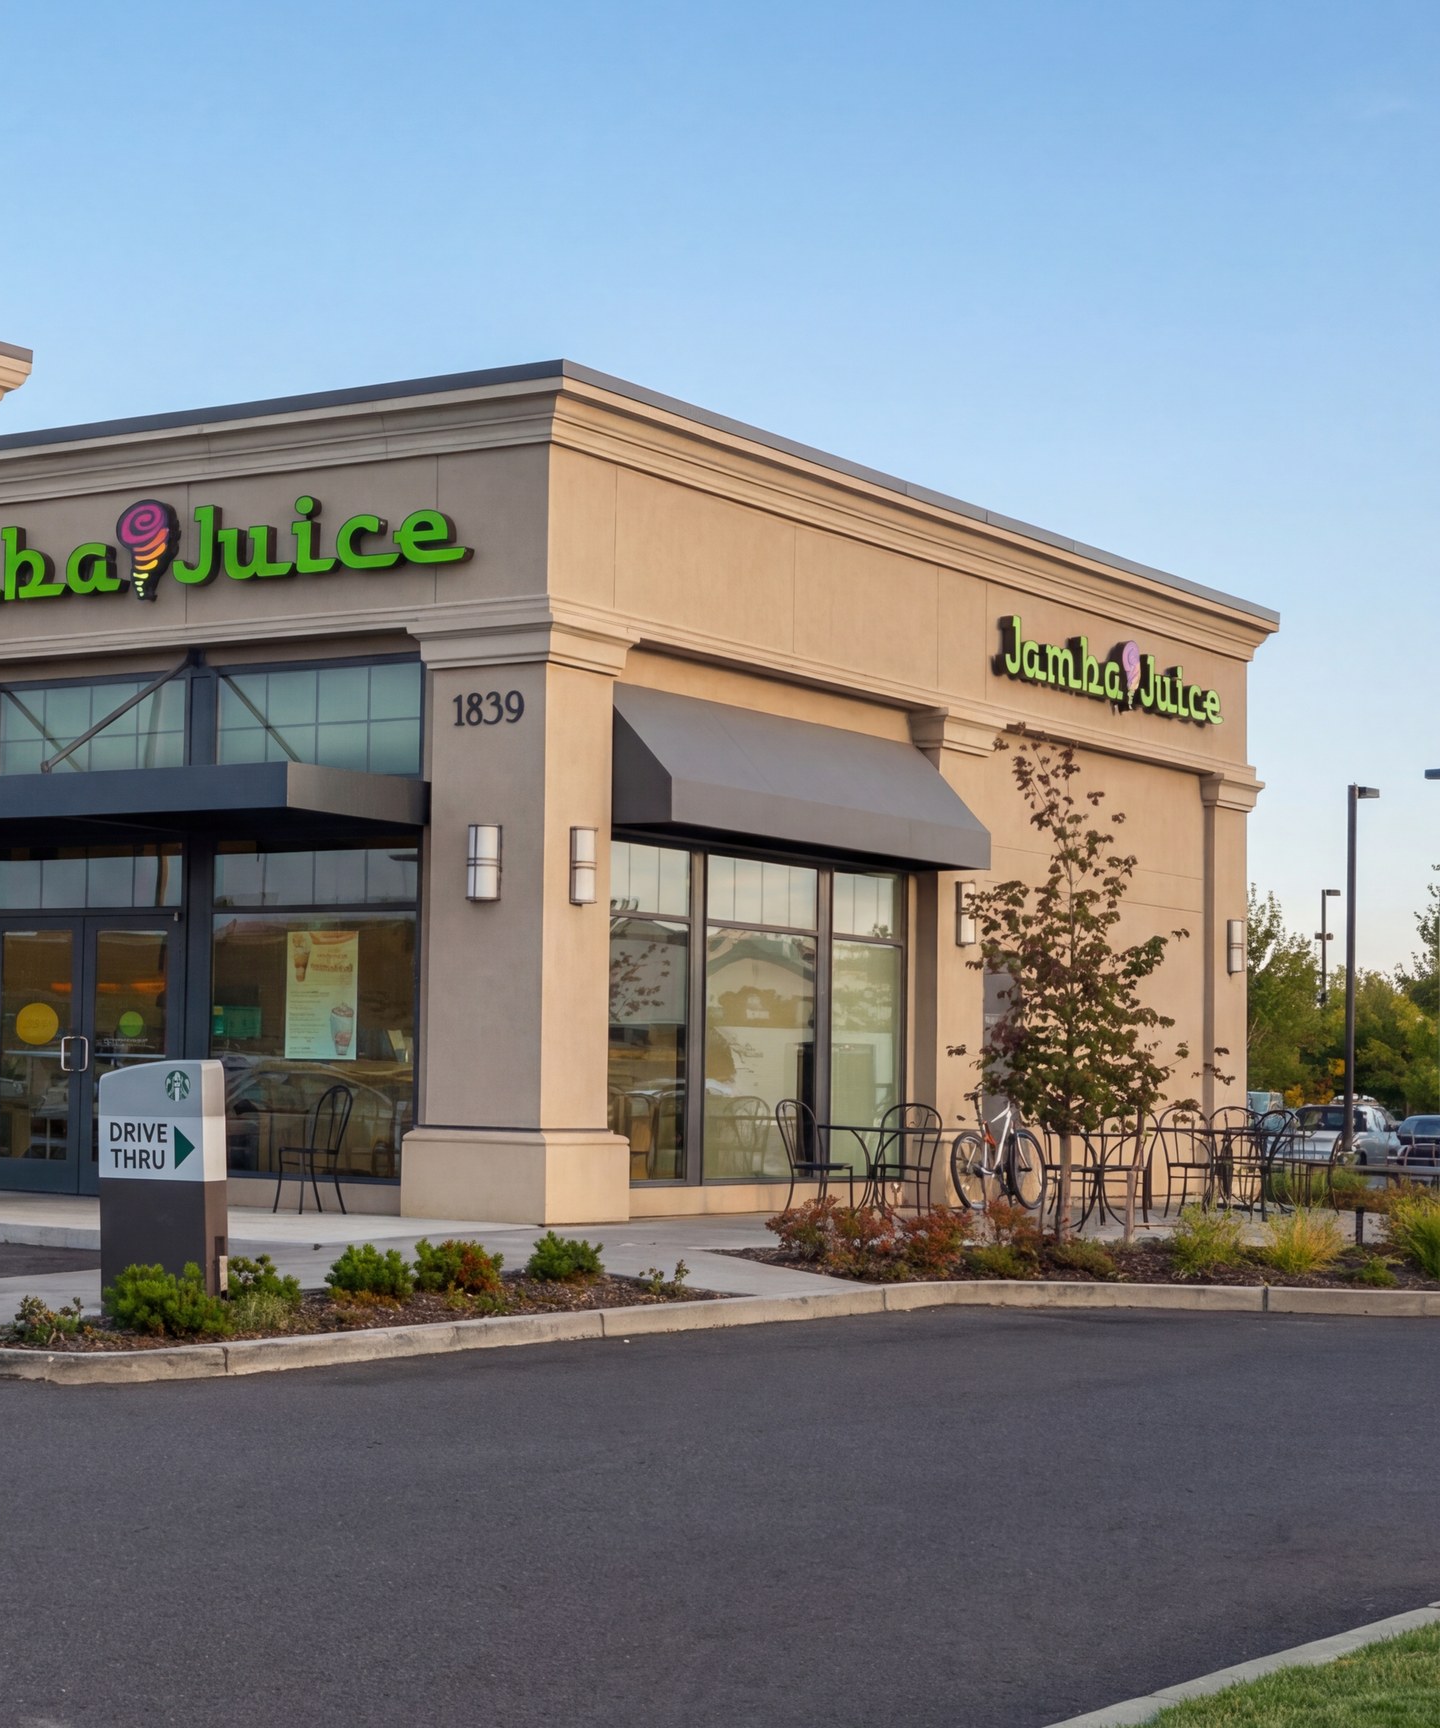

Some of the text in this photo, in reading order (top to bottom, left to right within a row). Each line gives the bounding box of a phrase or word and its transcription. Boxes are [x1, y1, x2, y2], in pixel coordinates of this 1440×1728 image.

[172, 496, 474, 585] Juice
[1003, 615, 1224, 724] Jamba Juice
[452, 689, 525, 726] 1839
[109, 1122, 167, 1143] DRIVE
[110, 1148, 165, 1169] THRU
